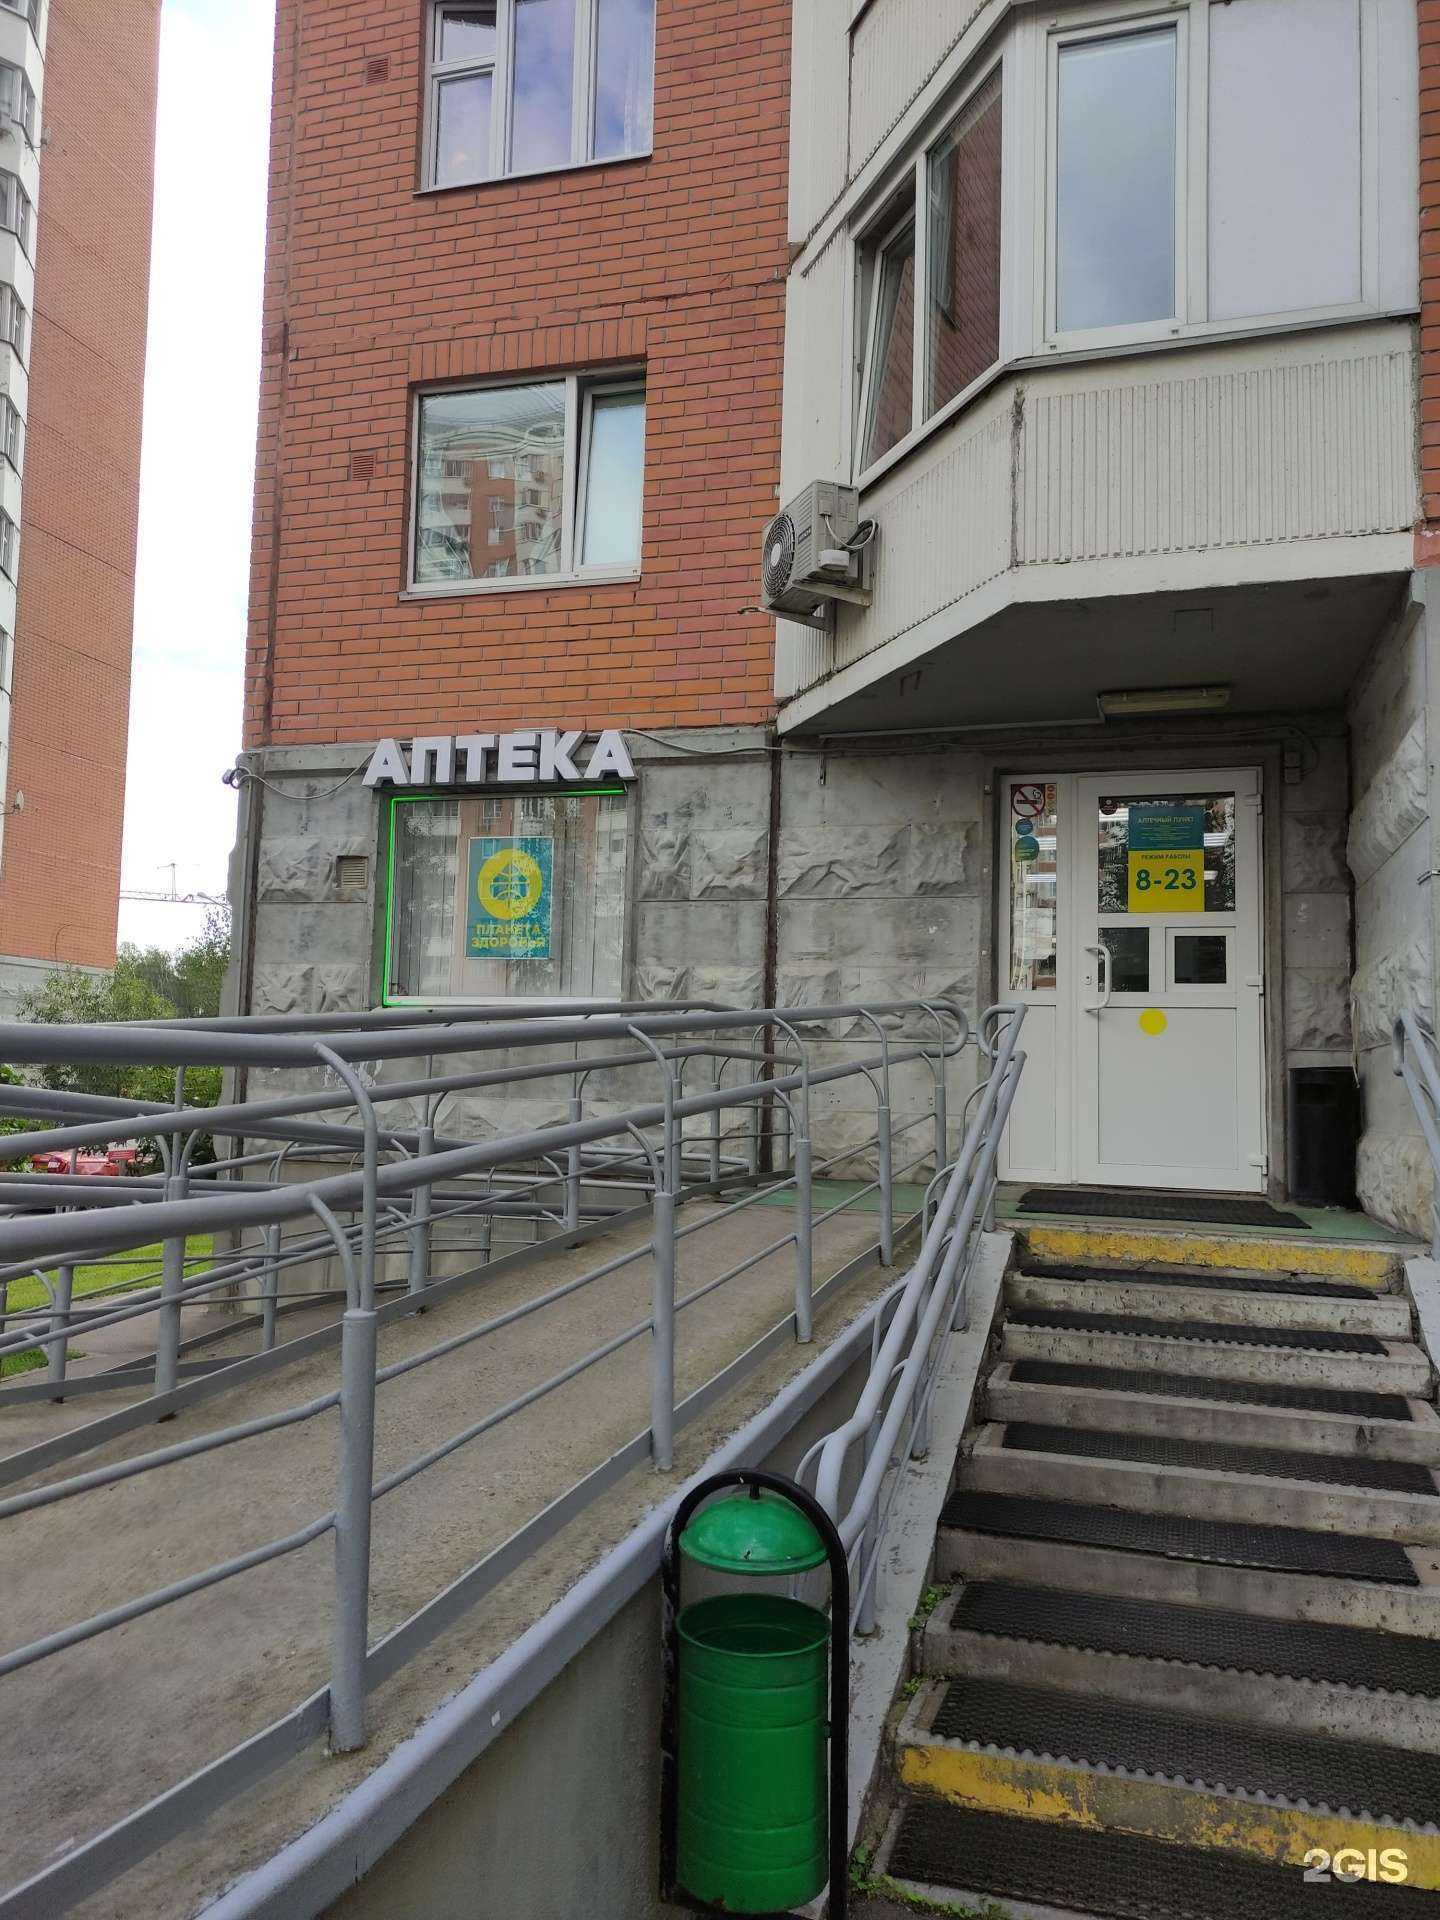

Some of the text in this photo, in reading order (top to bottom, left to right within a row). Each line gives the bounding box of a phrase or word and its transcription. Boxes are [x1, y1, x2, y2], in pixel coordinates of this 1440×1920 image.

[361, 729, 637, 786] АПТЕКА
[1136, 868, 1197, 890] 8-23
[476, 924, 541, 936] ПЛАНЕТА
[471, 936, 545, 949] ЗДОРОВЬЯ
